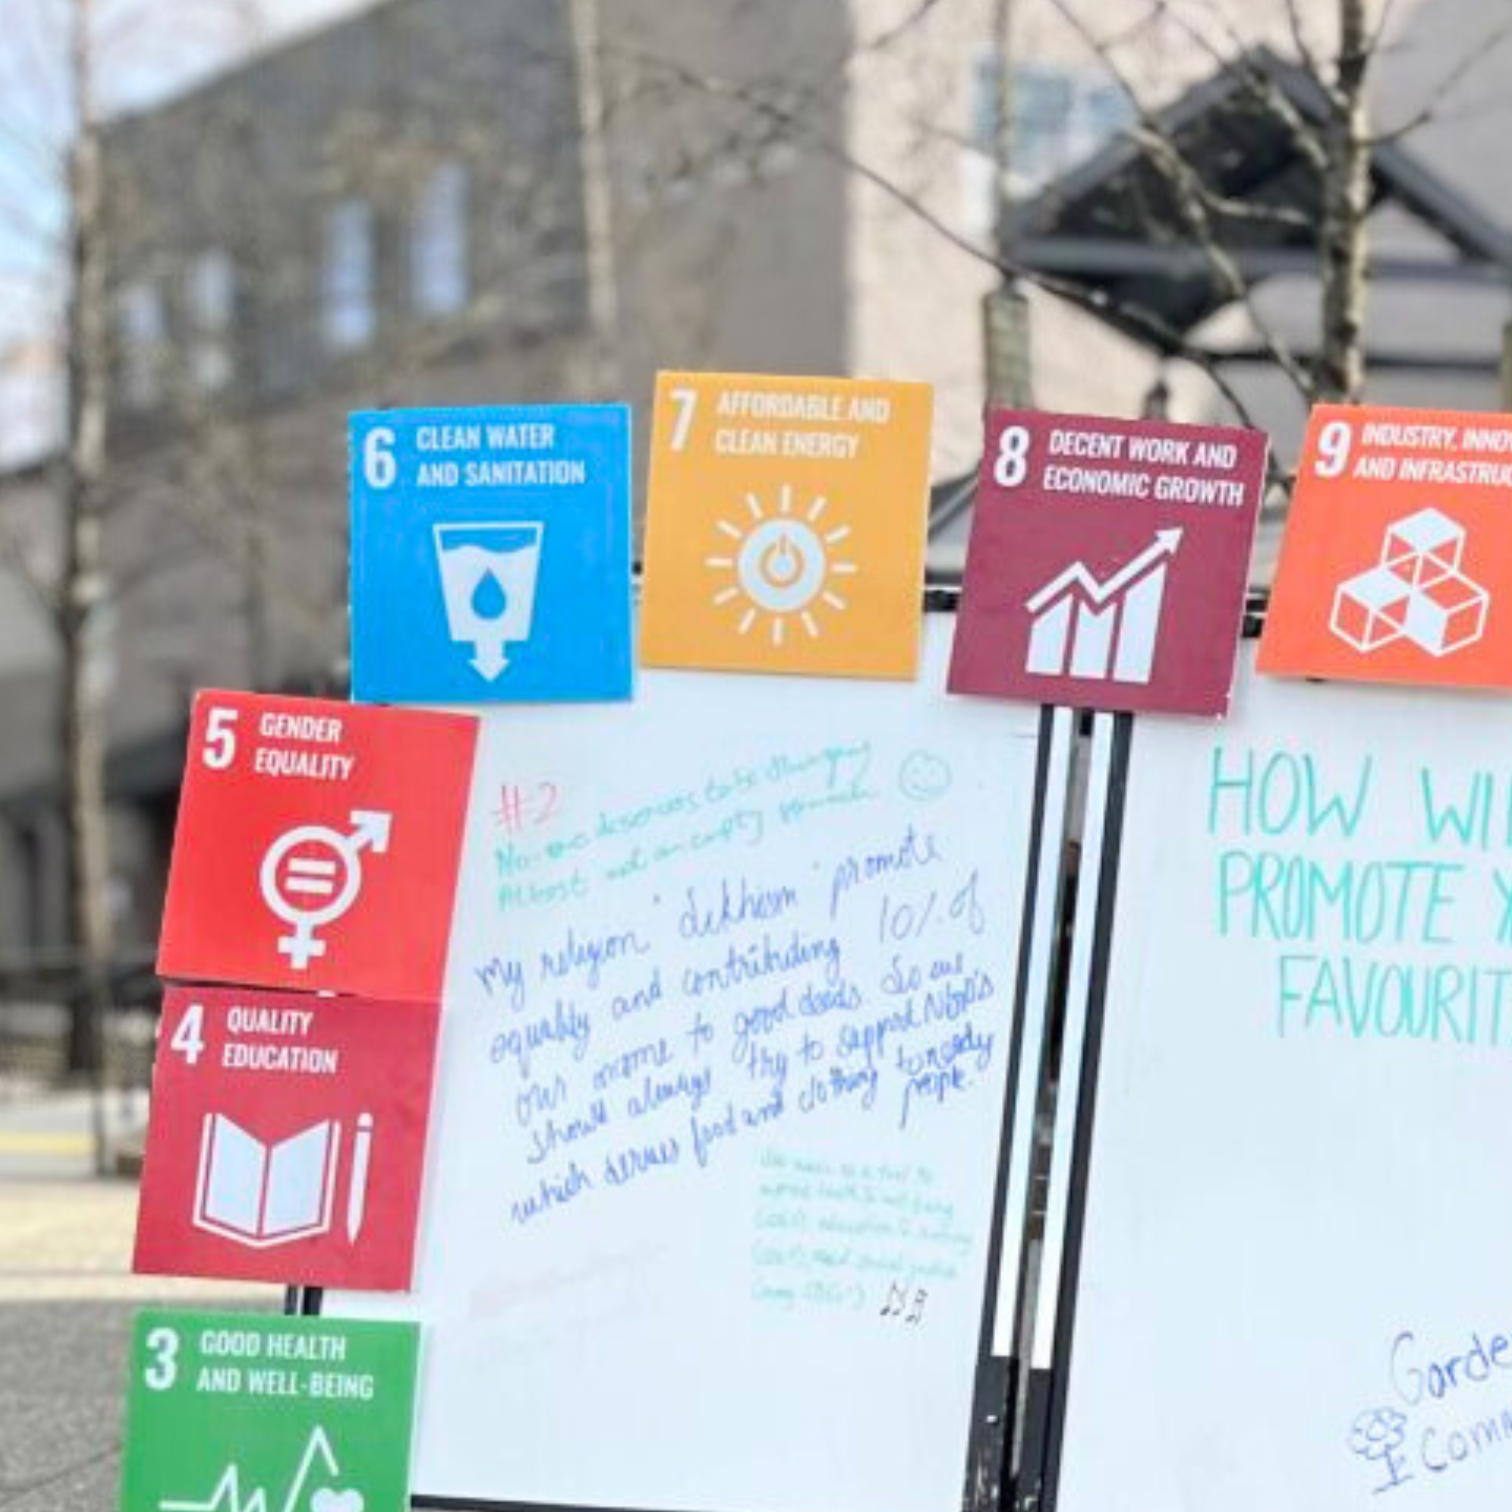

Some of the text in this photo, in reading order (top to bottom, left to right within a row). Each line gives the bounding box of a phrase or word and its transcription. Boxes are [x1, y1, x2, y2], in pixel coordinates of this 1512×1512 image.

[670, 388, 697, 451] 7
[716, 390, 890, 424] AFFORDABLE AND
[416, 422, 556, 451] CLEAN WATER
[716, 429, 860, 459] CLEAN ENERGY
[994, 425, 1030, 488] 8
[1049, 429, 1238, 470] DECENT WORK AND
[1314, 420, 1351, 478] 9
[364, 426, 397, 490] 6
[417, 460, 586, 487] AND SANITATION
[1353, 456, 1395, 481] AND
[1043, 465, 1245, 507] ECONOMIC GROWTH
[202, 707, 239, 770] 5
[259, 711, 343, 744] GENDER
[254, 747, 355, 781] EQUALITY
[1206, 745, 1373, 840] HOW
[1217, 849, 1466, 945] PROMOTE
[611, 966, 664, 1021] and
[948, 866, 987, 936] of
[170, 1003, 205, 1066] 4
[227, 1005, 314, 1036] QUALITY
[685, 1010, 715, 1057] to
[731, 985, 797, 1064] good
[222, 1043, 339, 1074] EDUCATION
[796, 1028, 825, 1068] to
[510, 1158, 596, 1226] which
[689, 1102, 738, 1169] food
[741, 1088, 785, 1128] and
[145, 1326, 180, 1391] 3
[200, 1330, 347, 1362] GOOD HEALTH
[196, 1368, 375, 1401] AND WELL-BEING
